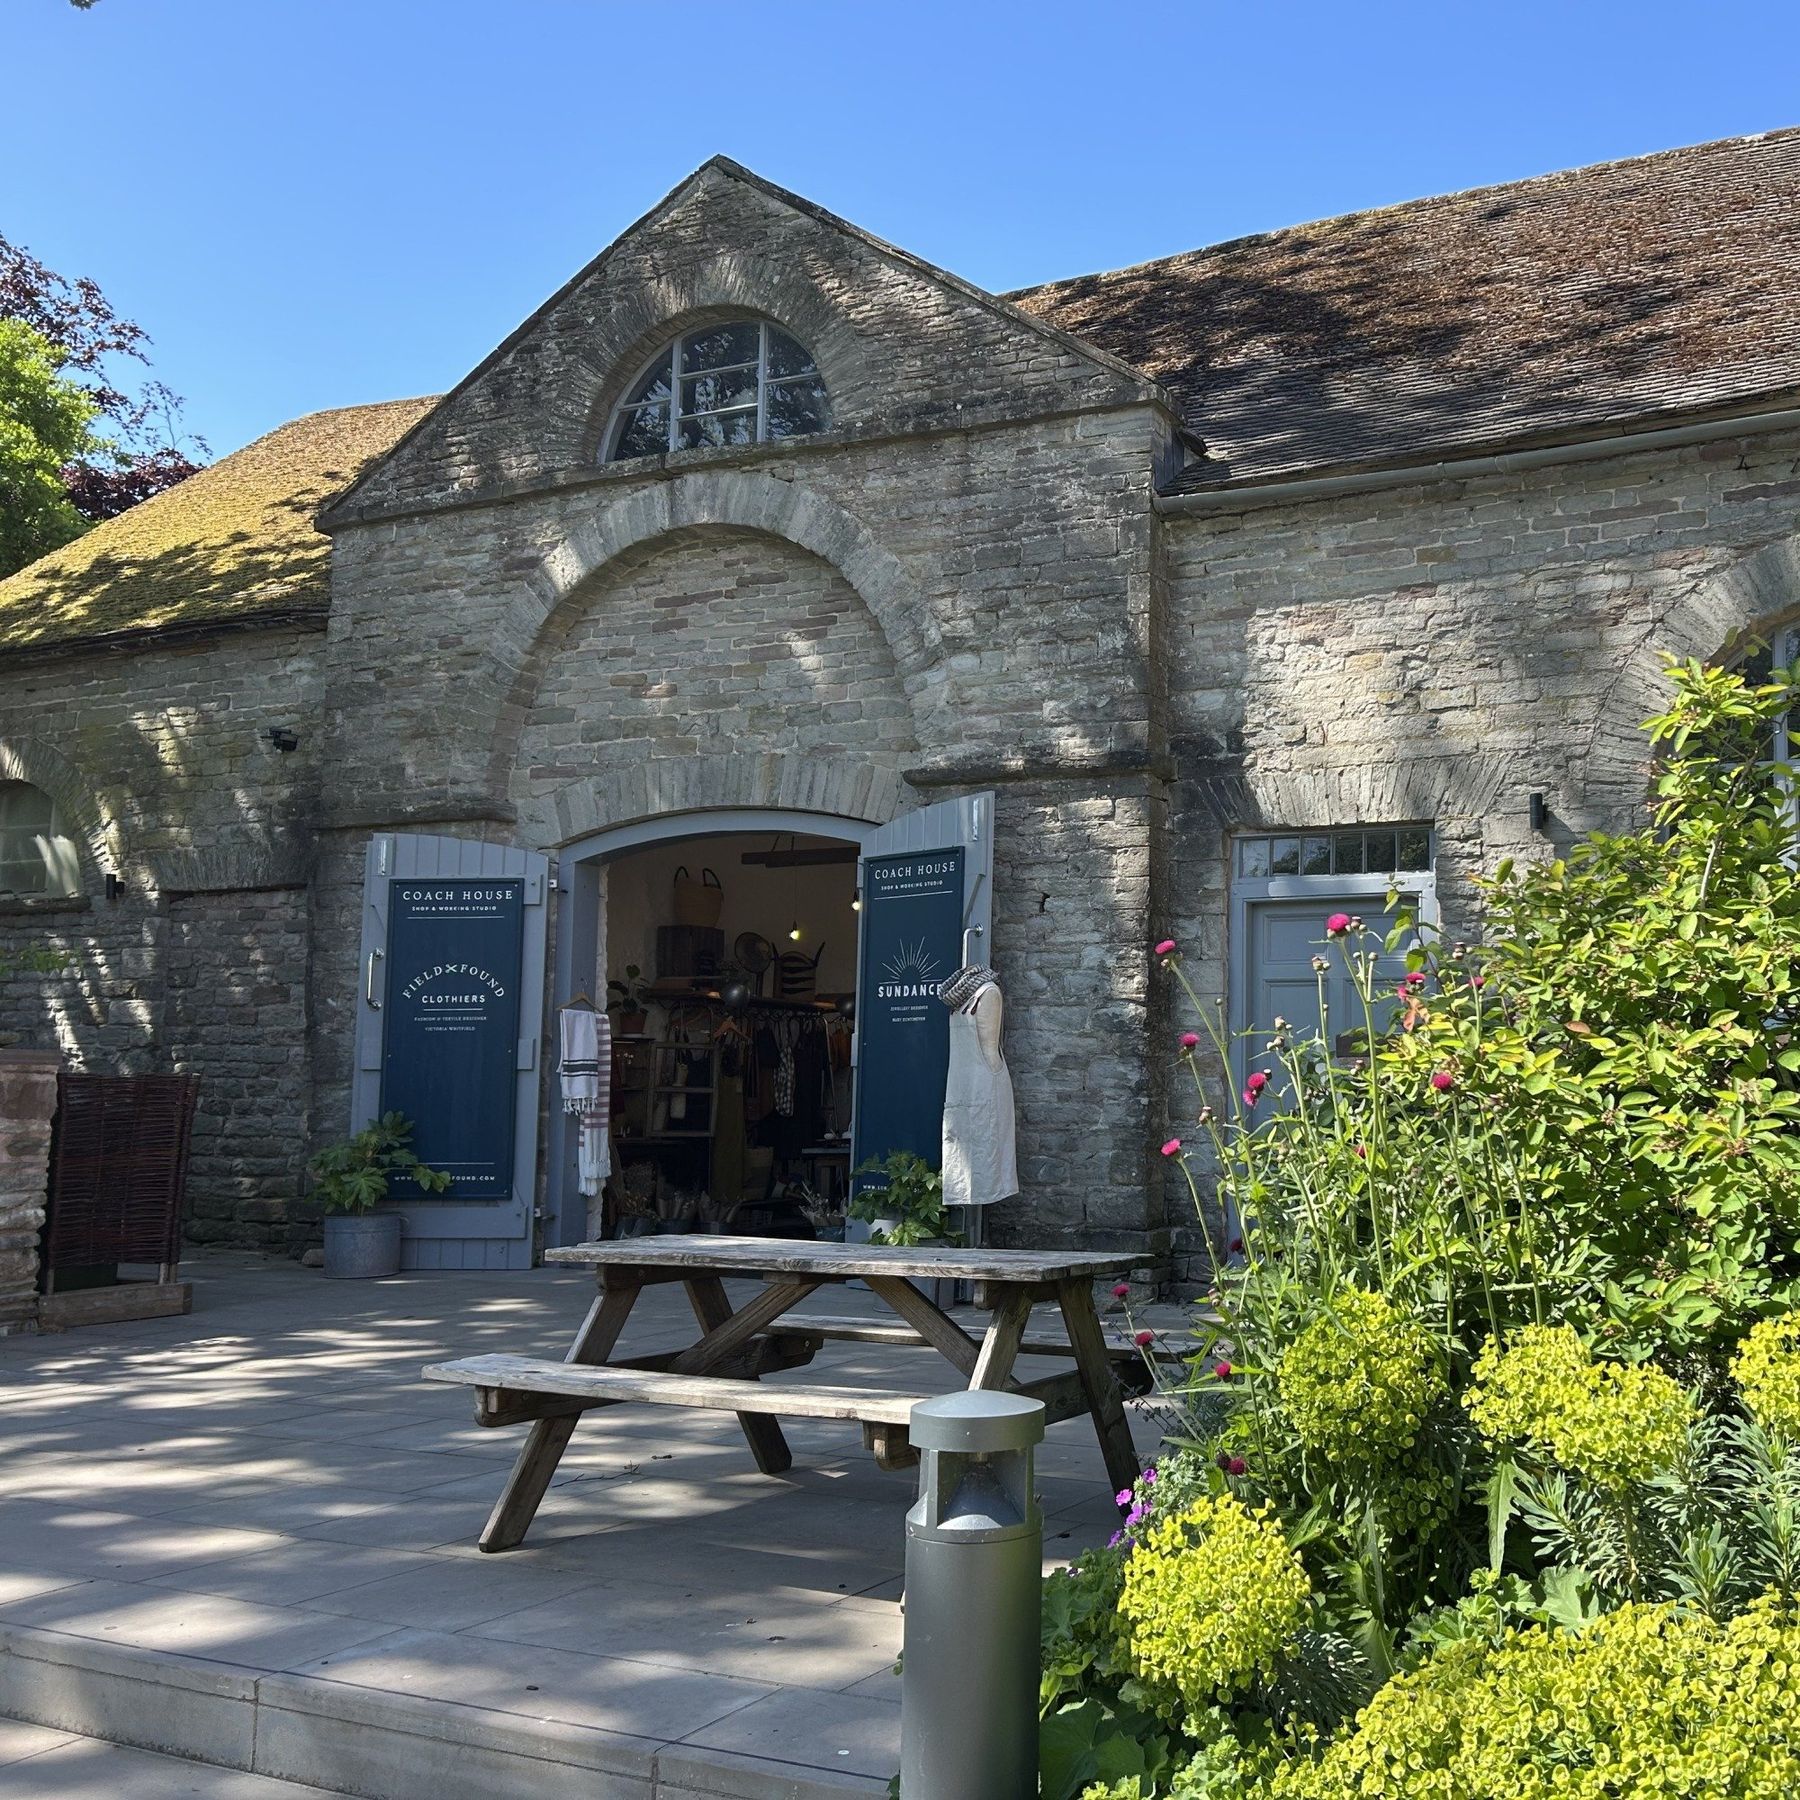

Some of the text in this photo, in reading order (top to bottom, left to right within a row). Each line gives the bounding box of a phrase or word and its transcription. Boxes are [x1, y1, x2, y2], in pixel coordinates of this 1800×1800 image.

[874, 861, 955, 880] COACH HOUSE
[402, 890, 513, 901] COACH HOUSE
[402, 964, 505, 999] FIELD FOUND
[422, 994, 485, 1003] CLOTHIERS
